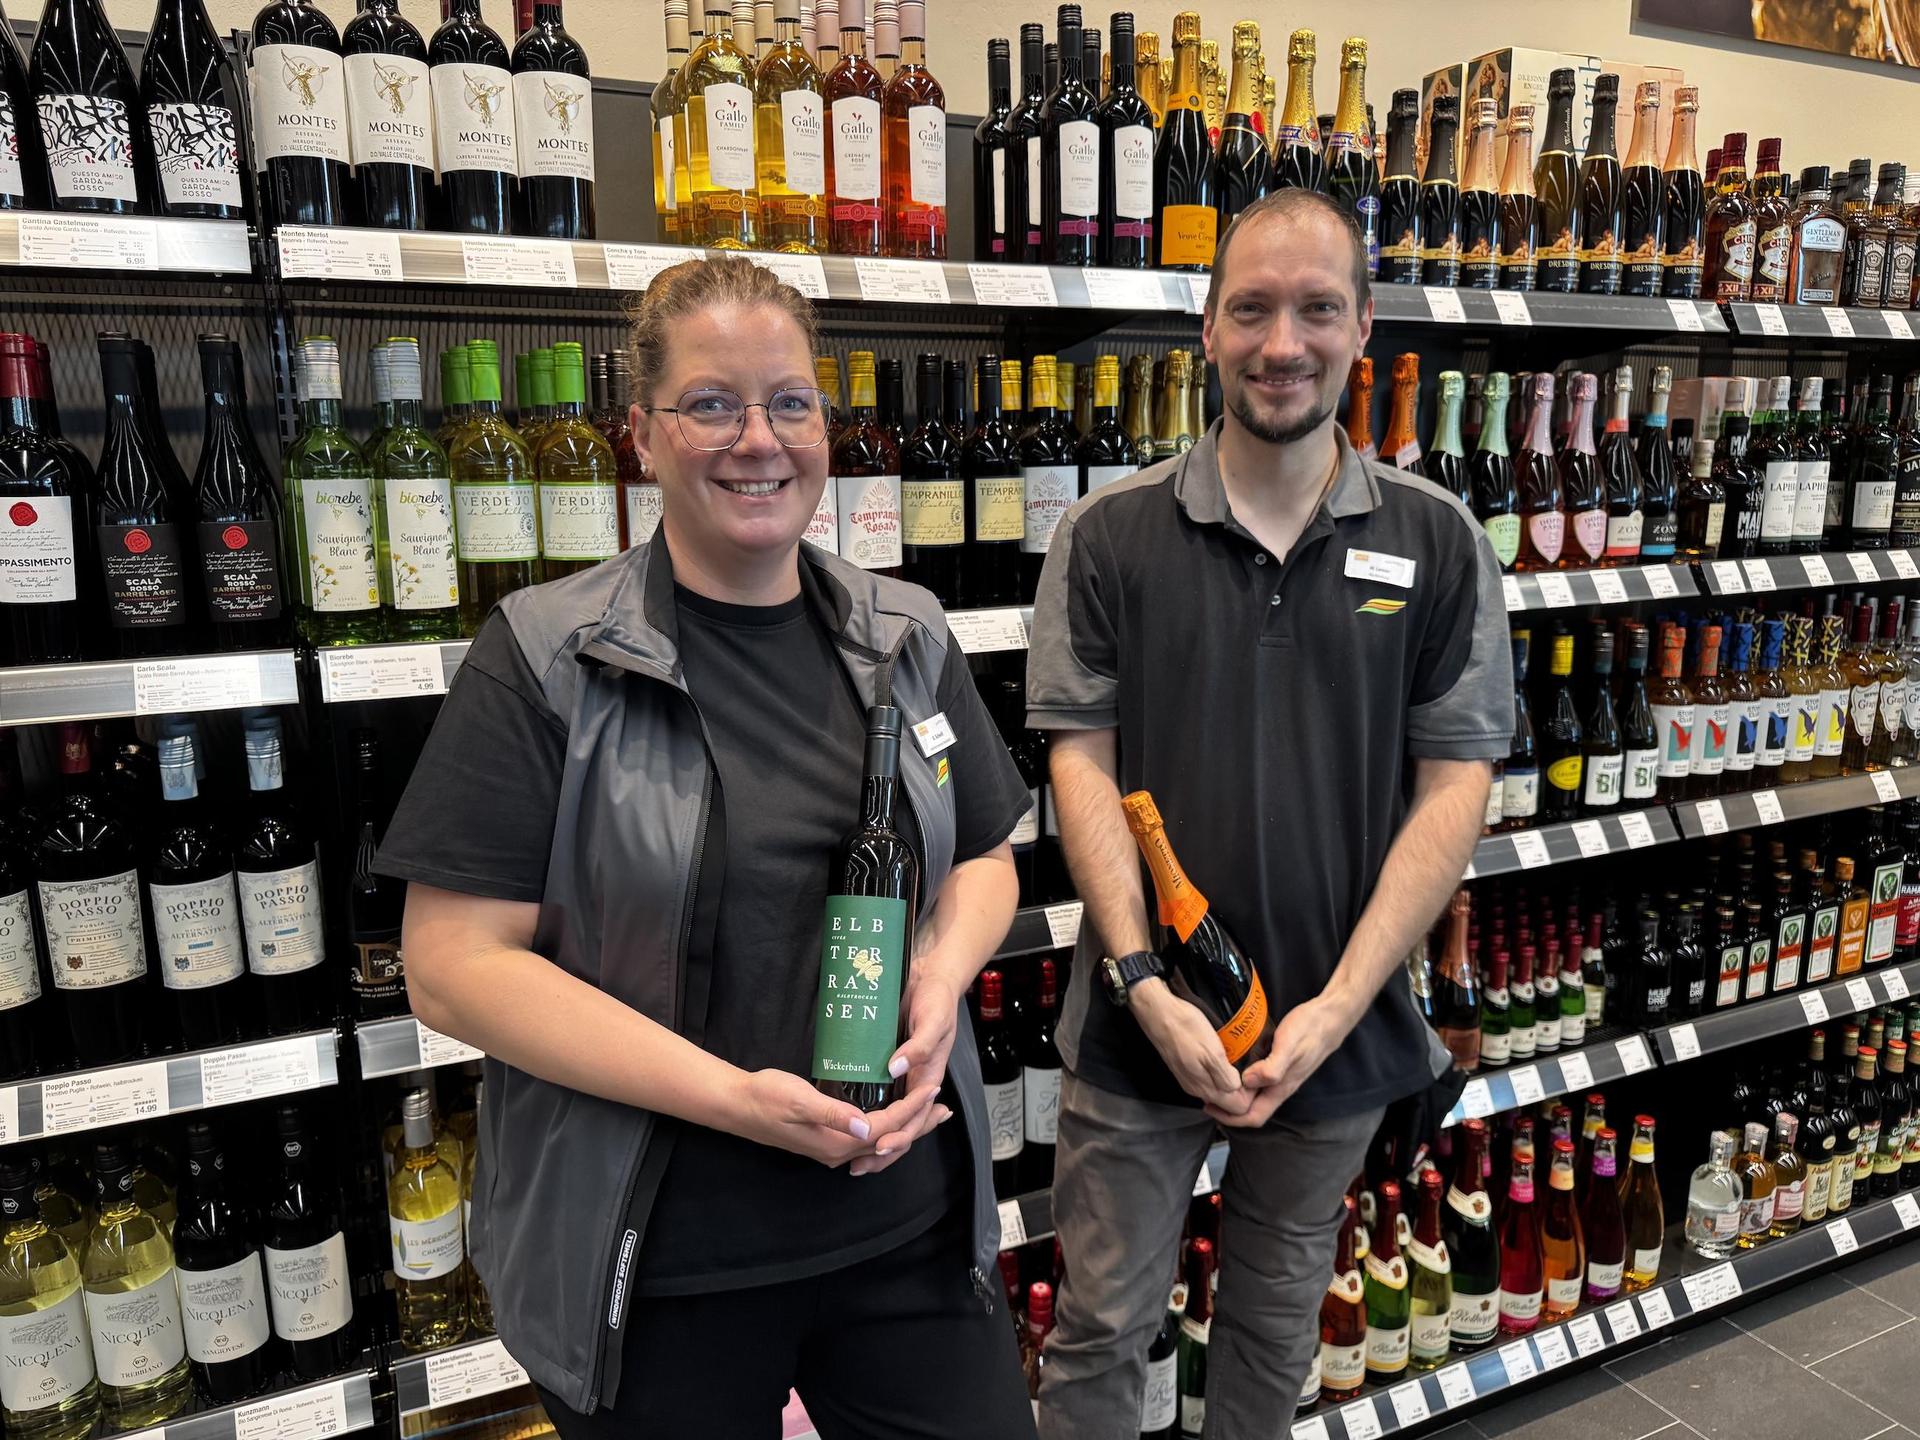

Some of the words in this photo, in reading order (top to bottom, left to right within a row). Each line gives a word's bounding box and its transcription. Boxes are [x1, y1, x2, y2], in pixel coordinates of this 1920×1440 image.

[278, 114, 336, 131] MONTES
[715, 109, 748, 123] Gallo
[791, 115, 821, 130] Gallo
[368, 121, 424, 138] MONTES
[840, 122, 873, 135] Gallo
[458, 131, 512, 147] MONTES
[918, 129, 944, 144] Gallo
[537, 138, 589, 153] MONTES
[1068, 143, 1096, 158] Gallo
[1123, 148, 1149, 160] Gallo
[72, 177, 103, 185] GARDA
[181, 182, 211, 191] GARDA
[73, 184, 105, 193] ROSSO
[181, 189, 212, 199] ROSSO
[22, 217, 52, 226] Cantina
[53, 218, 100, 228] Castelnuovo
[281, 230, 306, 238] Montes
[307, 231, 329, 239] Merlot
[1805, 229, 1842, 238] GENTLEMAN
[316, 490, 363, 506] biorebe
[399, 490, 445, 505] biorebe
[461, 495, 530, 508] VERDEJO
[863, 521, 897, 534] Rosado
[317, 534, 368, 548] Sauvignon
[400, 533, 449, 547] Sauvignon
[329, 546, 358, 557] Blanc
[413, 545, 441, 556] Blanc
[125, 577, 163, 586] SCALA
[223, 573, 258, 582] SCALA
[227, 580, 256, 588] ROSSO
[114, 590, 150, 598] BARREL
[152, 588, 177, 597] AGED
[212, 585, 246, 594] BARREL
[329, 653, 354, 661] Biorebe
[137, 665, 156, 673] Carlo
[417, 682, 434, 691] 4.99
[254, 884, 310, 902] DOPPIO
[58, 895, 122, 912] DOPPIO
[166, 897, 225, 915] DOPPIO
[259, 894, 307, 910] PASSO
[65, 905, 118, 920] PASSO
[172, 906, 221, 923] PASSO
[257, 911, 312, 927] ALTERNATIVA
[832, 917, 884, 933] ELB
[69, 931, 120, 943] PRIMITIVO
[170, 925, 227, 941] ALTERNATIVA
[830, 944, 883, 964] TER
[373, 958, 391, 966] TWO
[827, 974, 879, 991] RAS
[825, 1003, 878, 1020] SEN
[1229, 989, 1261, 1041] MIONETTO
[203, 1056, 226, 1065] Doppio
[227, 1052, 247, 1061] Passo
[822, 1057, 871, 1073] Wackerbarth
[45, 1082, 70, 1092] Doppio
[71, 1078, 92, 1088] Passo
[45, 1088, 69, 1098] Primitivo
[69, 1085, 86, 1095] Puglia
[135, 1103, 158, 1115] 14.99
[611, 1278, 624, 1324] WINDPROOF
[619, 1233, 635, 1279] SOFTSHELL
[274, 1278, 339, 1300] NICOLENA
[186, 1299, 255, 1322] NICOLENA
[99, 1316, 173, 1345] NICOLENA
[5, 1335, 82, 1368] NICOLENA
[120, 1361, 164, 1379] TREBBIANO
[428, 1360, 439, 1368] Les
[505, 1373, 520, 1384] 5.99
[27, 1382, 73, 1403] TREBBIANO
[237, 1405, 271, 1418] Kunzmann
[321, 1423, 338, 1434] 4.99
